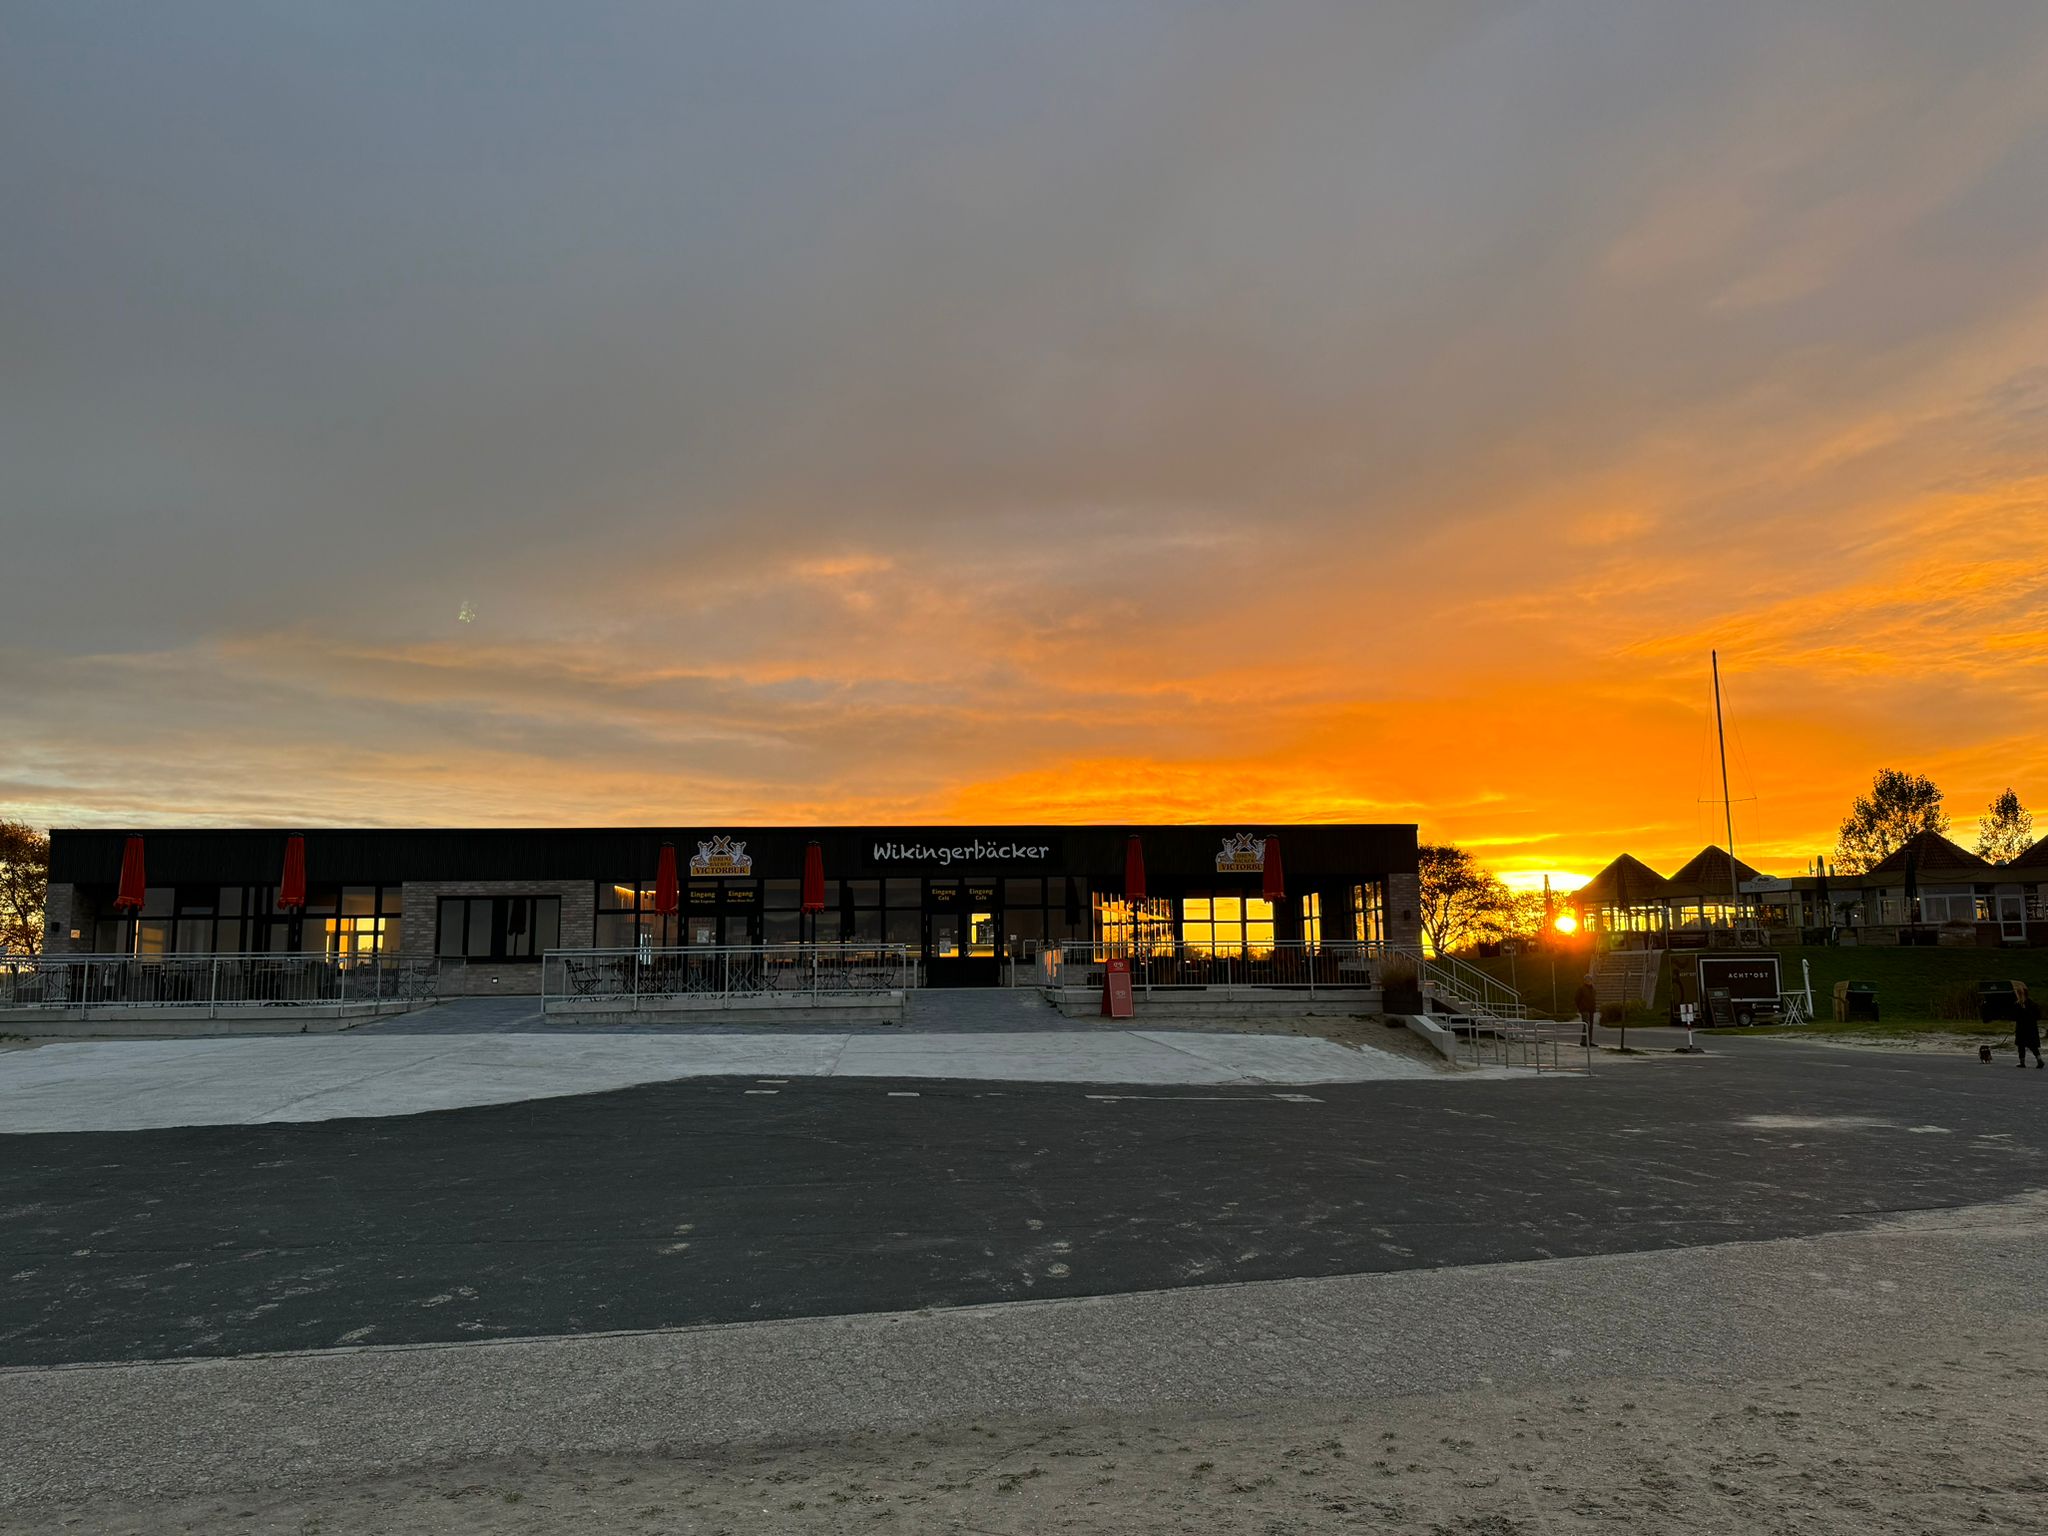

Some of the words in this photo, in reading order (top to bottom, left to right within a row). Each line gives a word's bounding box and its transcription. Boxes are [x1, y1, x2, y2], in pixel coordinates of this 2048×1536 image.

[873, 839, 1050, 865] Wikingerbäcker
[1221, 863, 1263, 871] VICTORBU
[728, 890, 754, 898] Eingang
[931, 888, 956, 896] Eingang
